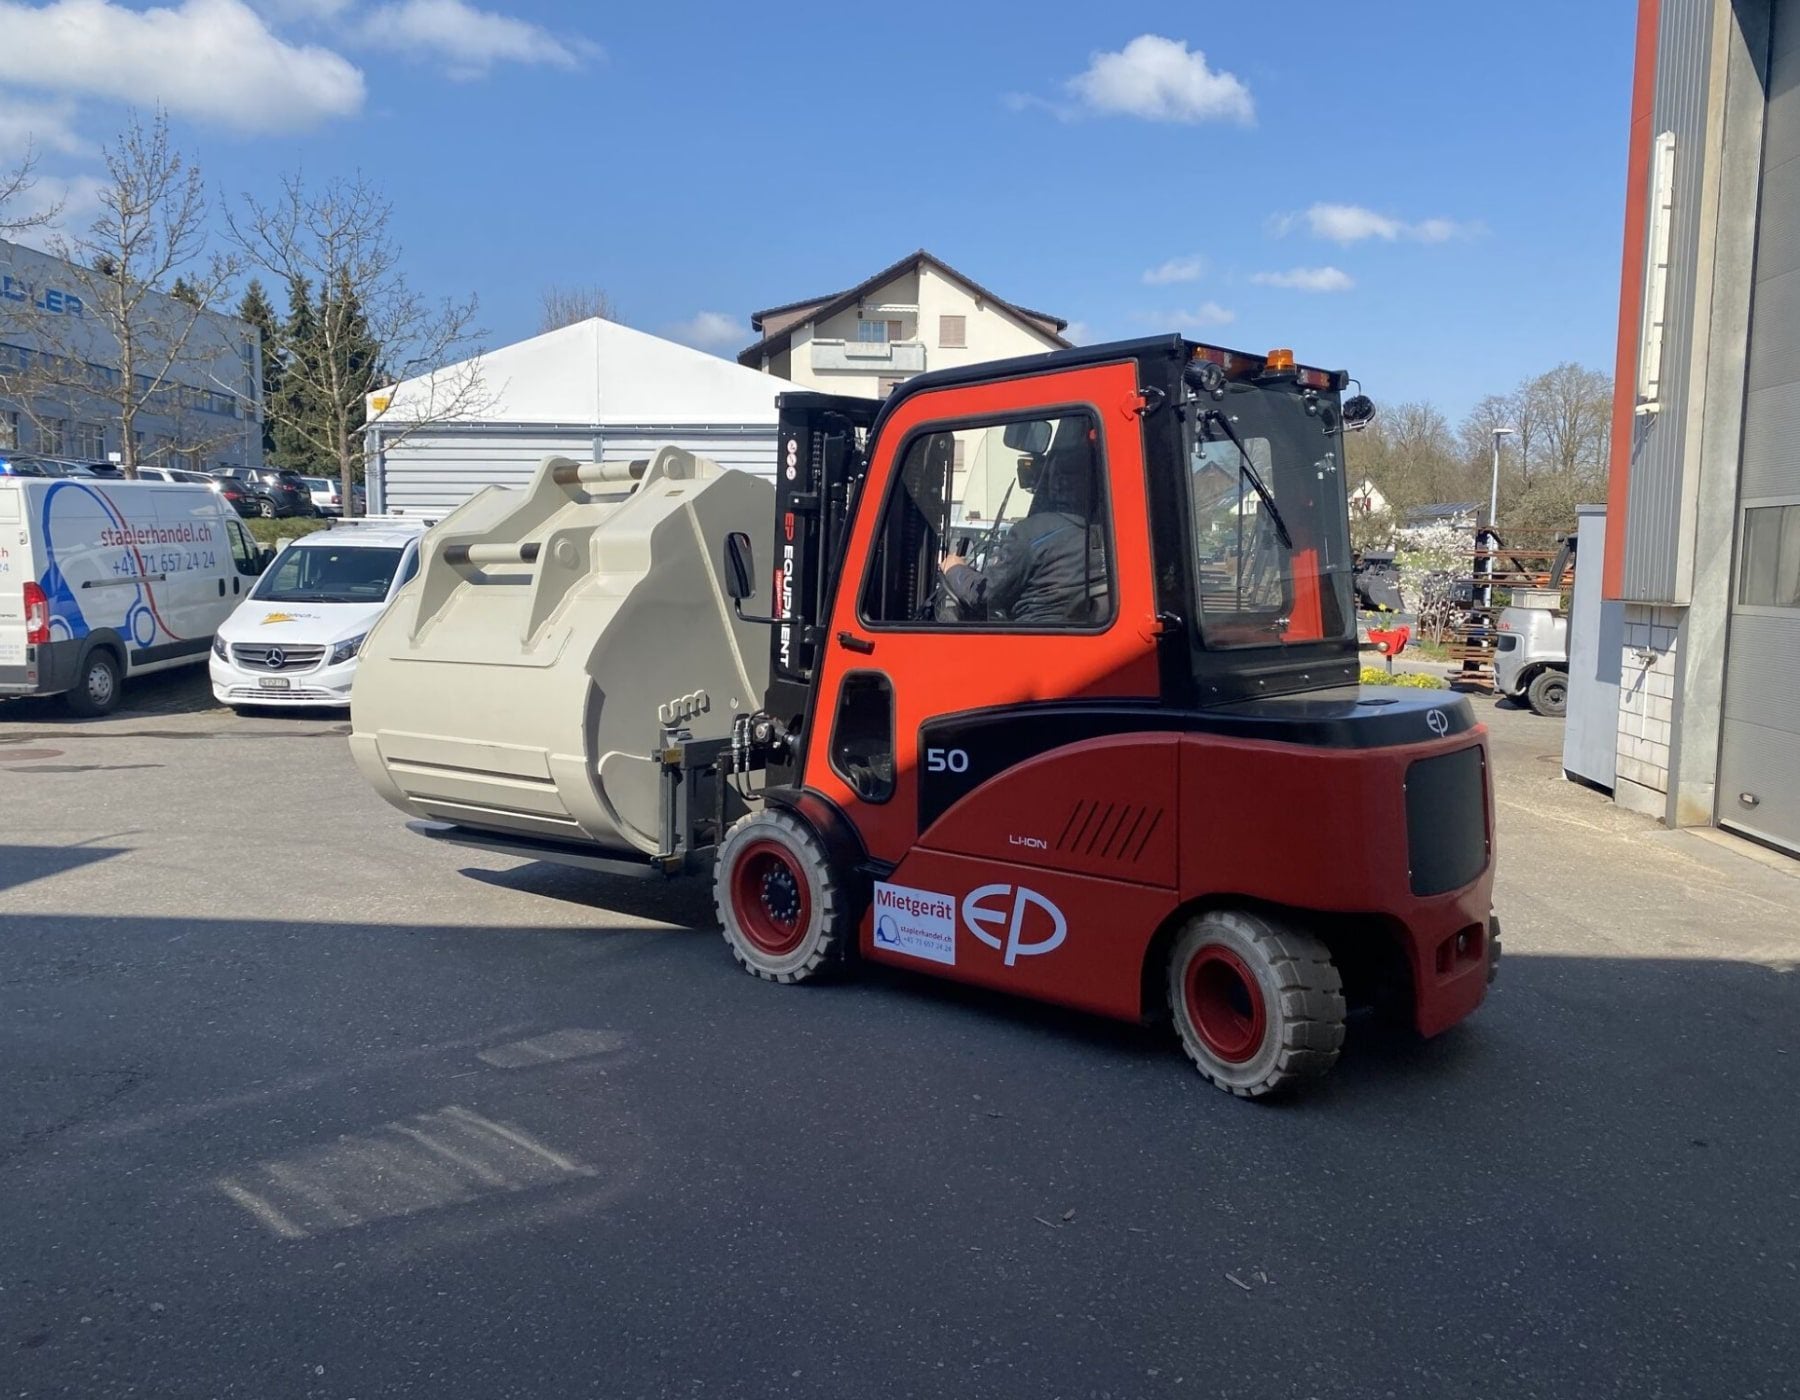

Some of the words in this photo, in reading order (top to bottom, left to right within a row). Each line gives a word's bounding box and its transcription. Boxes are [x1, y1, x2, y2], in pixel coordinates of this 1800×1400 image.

[0, 275, 83, 319] DLER
[101, 522, 213, 546] staplerhandel.ch
[784, 512, 795, 541] EP
[113, 556, 137, 575] +41
[142, 554, 157, 576] 71
[161, 553, 181, 572] 657
[186, 552, 199, 570] 24
[203, 551, 215, 568] 24
[928, 748, 969, 773] 50
[877, 889, 952, 920] Mietgerät
[900, 926, 952, 942] staplerhandel.ch
[962, 883, 1068, 967] EP
